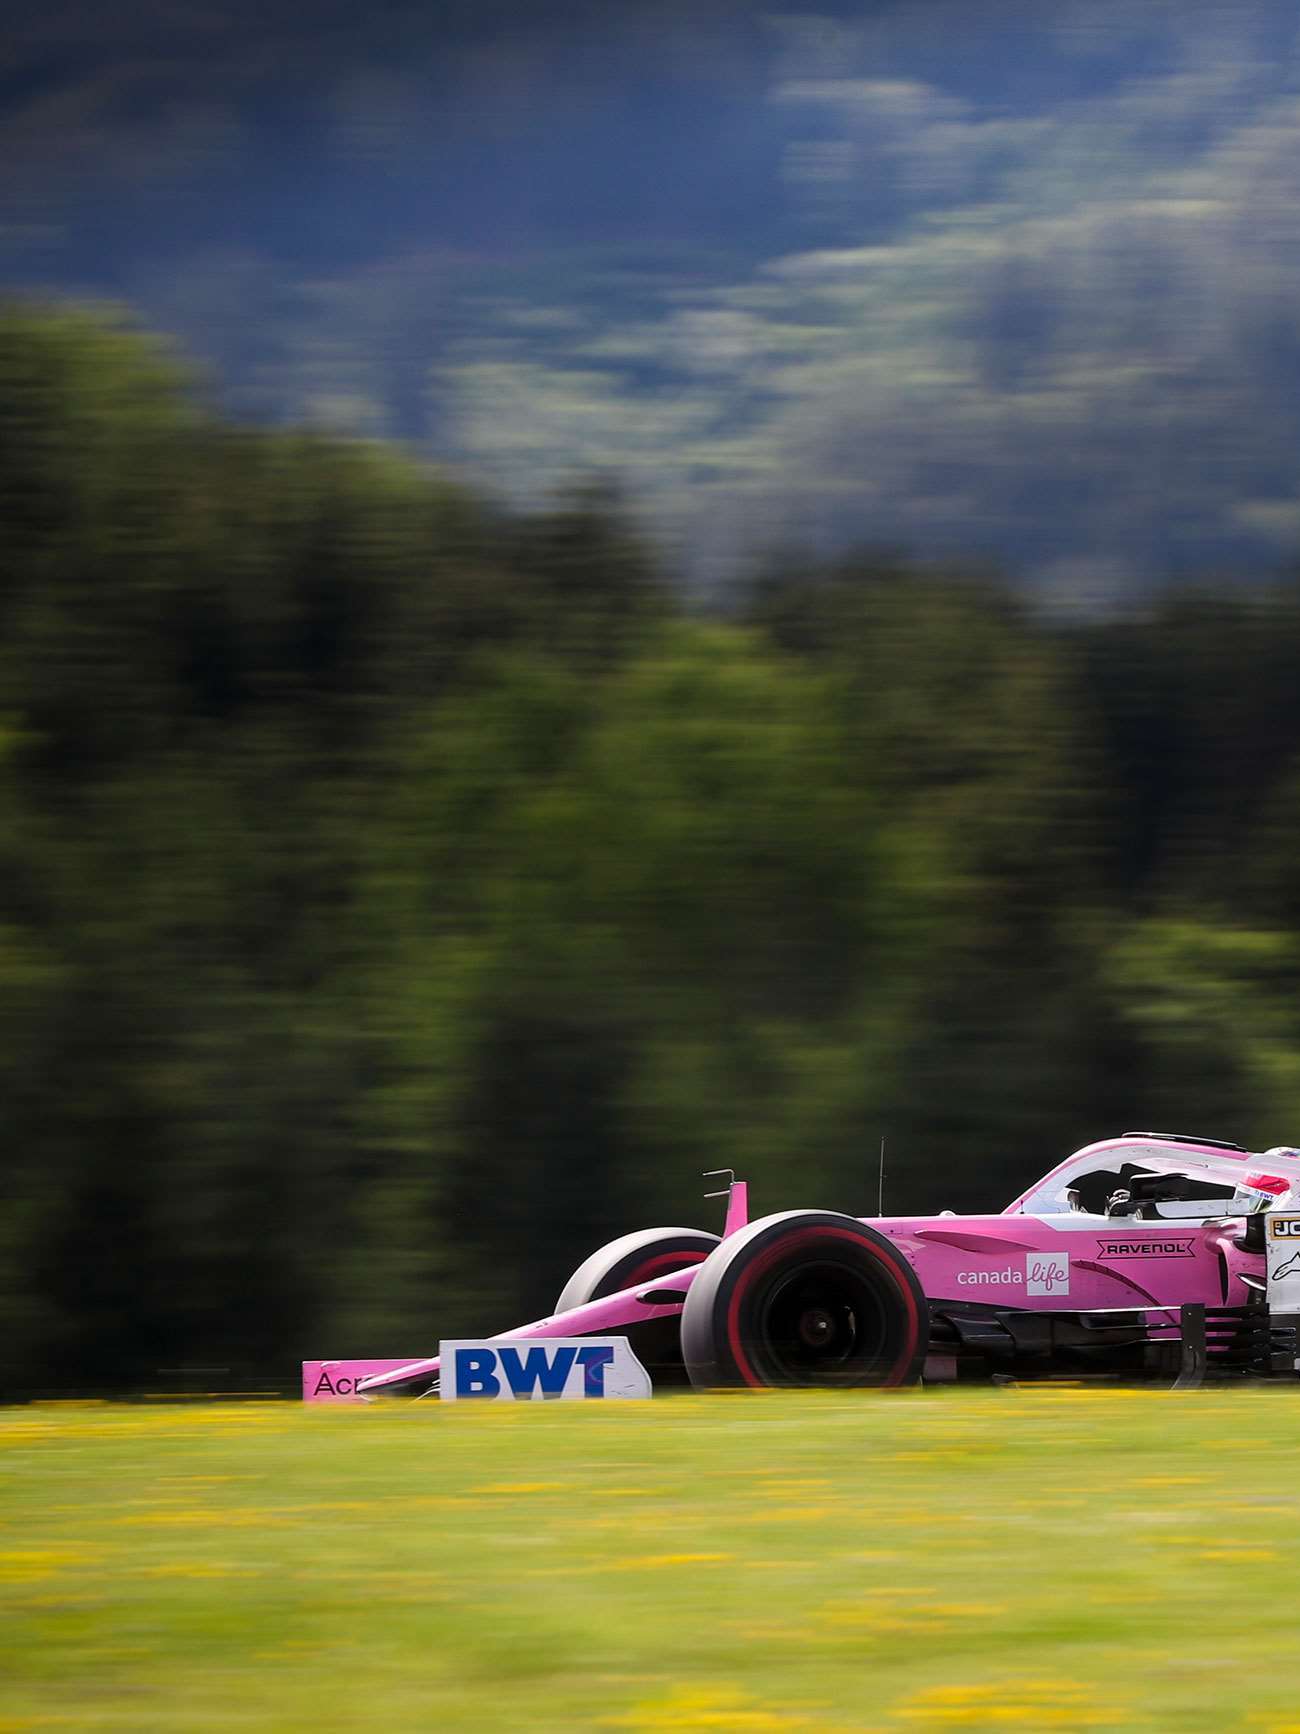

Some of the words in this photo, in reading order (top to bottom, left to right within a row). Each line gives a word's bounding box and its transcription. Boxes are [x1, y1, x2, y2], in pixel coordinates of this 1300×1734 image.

[1107, 1243, 1185, 1254] RAVENOL
[957, 1267, 1023, 1285] canada
[1027, 1262, 1069, 1291] life
[313, 1372, 373, 1396] Acr
[455, 1346, 614, 1399] BWT
